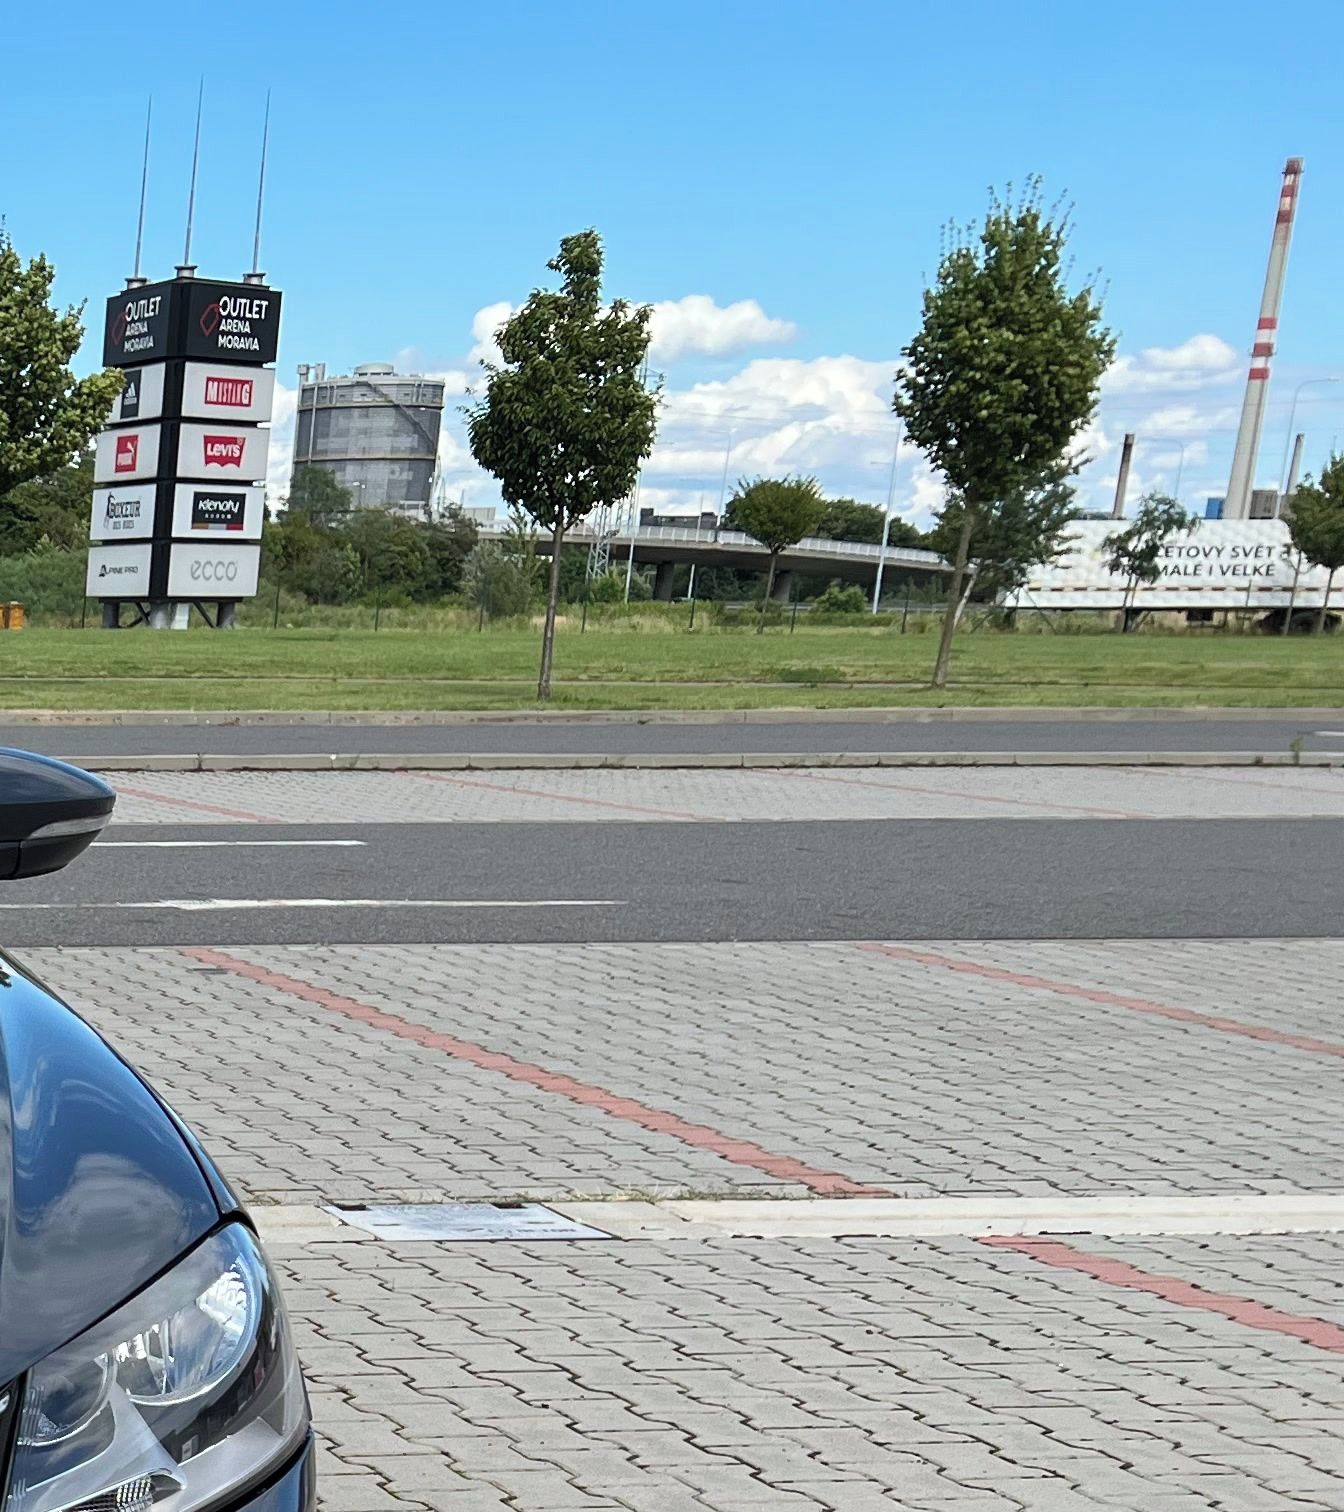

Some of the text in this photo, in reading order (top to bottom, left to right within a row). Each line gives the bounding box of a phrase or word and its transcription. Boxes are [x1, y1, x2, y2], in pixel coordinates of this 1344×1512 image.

[125, 296, 161, 321] OUTLET
[219, 296, 268, 319] OUTLET
[125, 321, 148, 336] ARENA
[220, 319, 251, 333] ARENA
[124, 336, 154, 352] MORAVIA
[218, 335, 259, 350] MORAVIA
[191, 560, 237, 581] ecco
